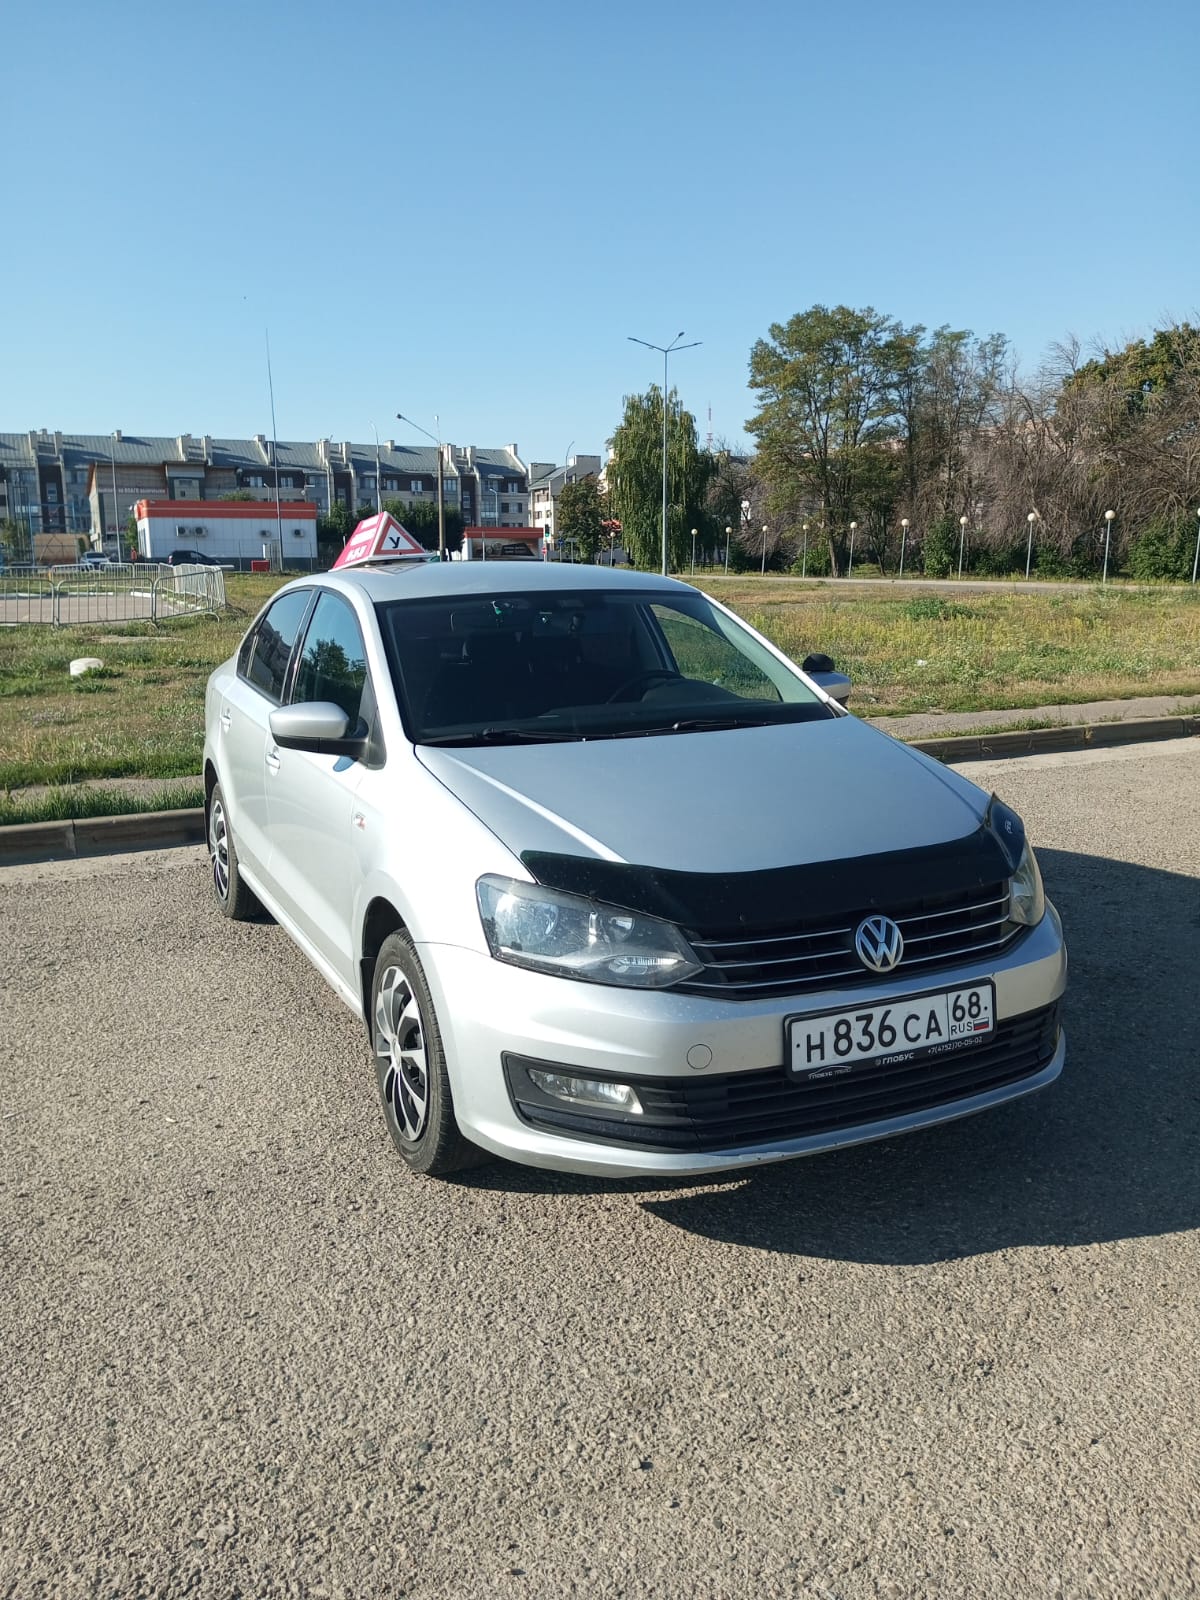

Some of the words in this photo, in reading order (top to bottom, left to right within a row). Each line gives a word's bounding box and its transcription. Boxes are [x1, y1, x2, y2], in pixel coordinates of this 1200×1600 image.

[389, 536, 401, 549] У
[952, 991, 982, 1023] 68
[950, 1020, 973, 1036] RUS
[882, 1052, 915, 1065] ГЛОБУС
